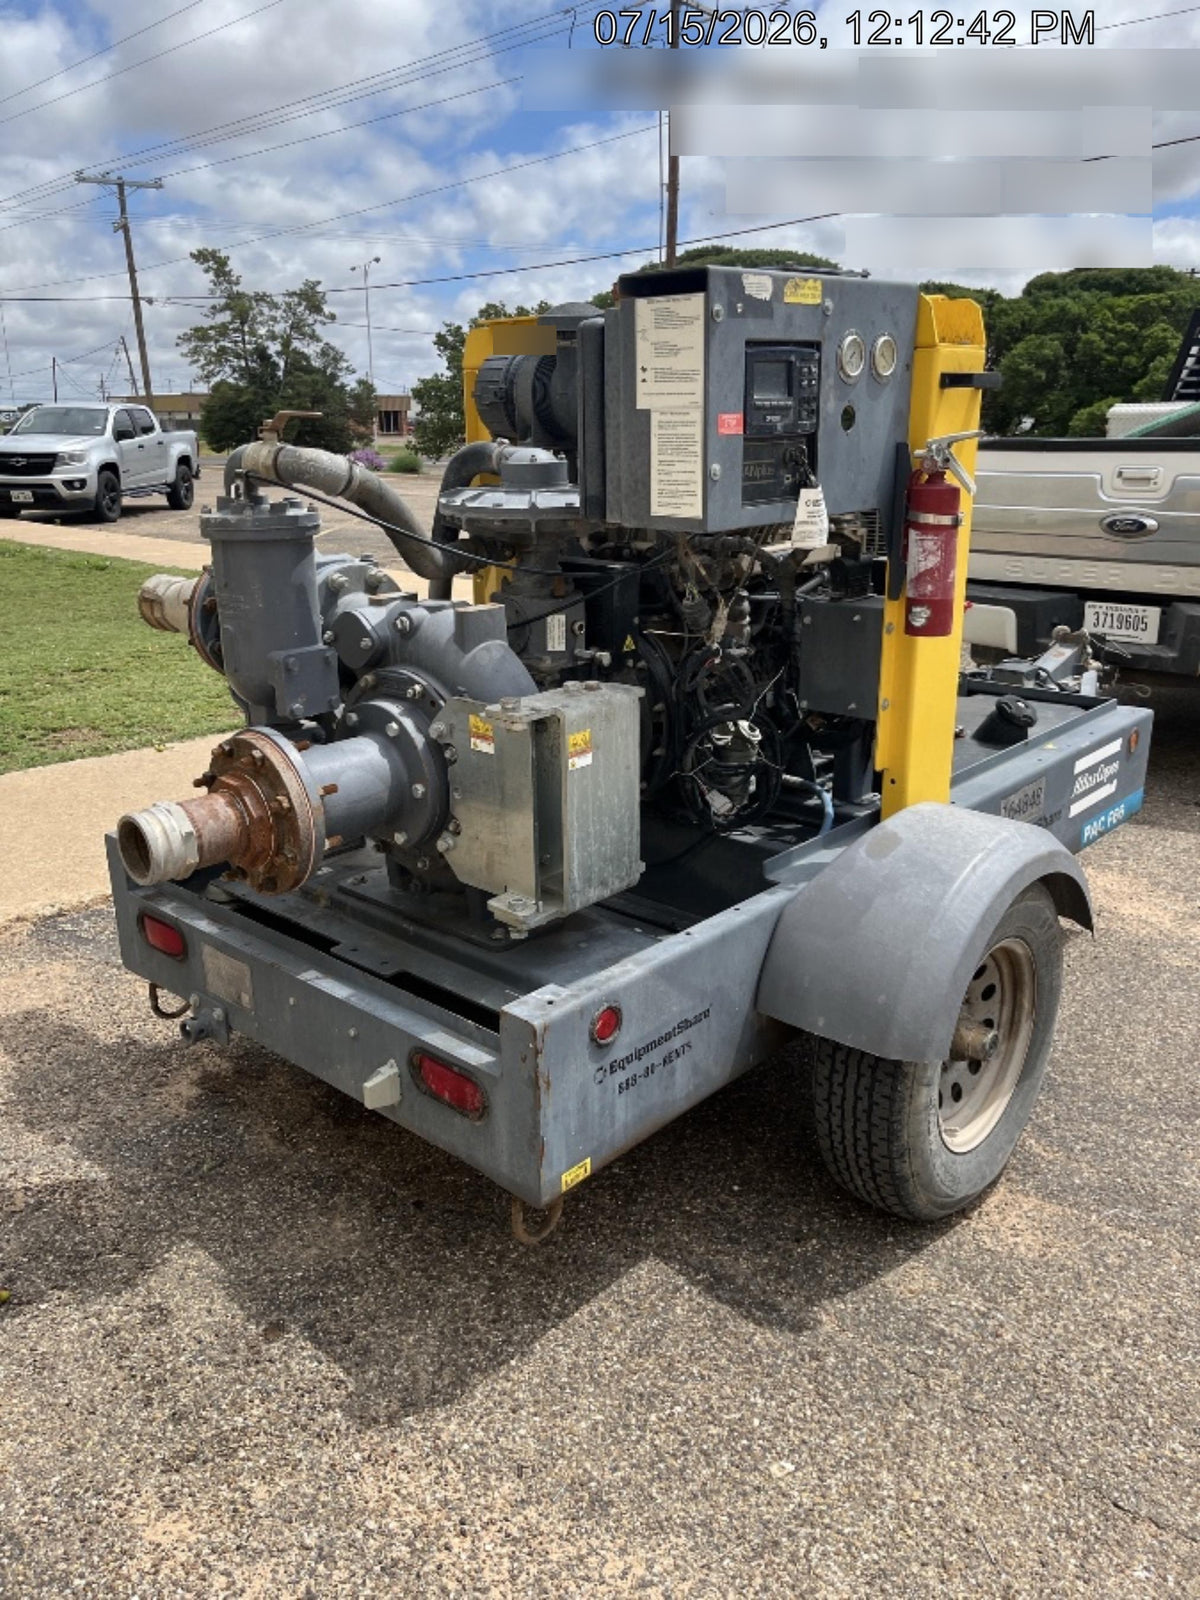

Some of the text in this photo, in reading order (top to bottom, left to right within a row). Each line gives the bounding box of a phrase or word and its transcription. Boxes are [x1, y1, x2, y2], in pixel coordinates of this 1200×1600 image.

[1004, 559, 1126, 585] SUPER
[1092, 611, 1149, 632] 3719605
[1082, 815, 1105, 843] PAC
[608, 1007, 711, 1076] EquipmentShare
